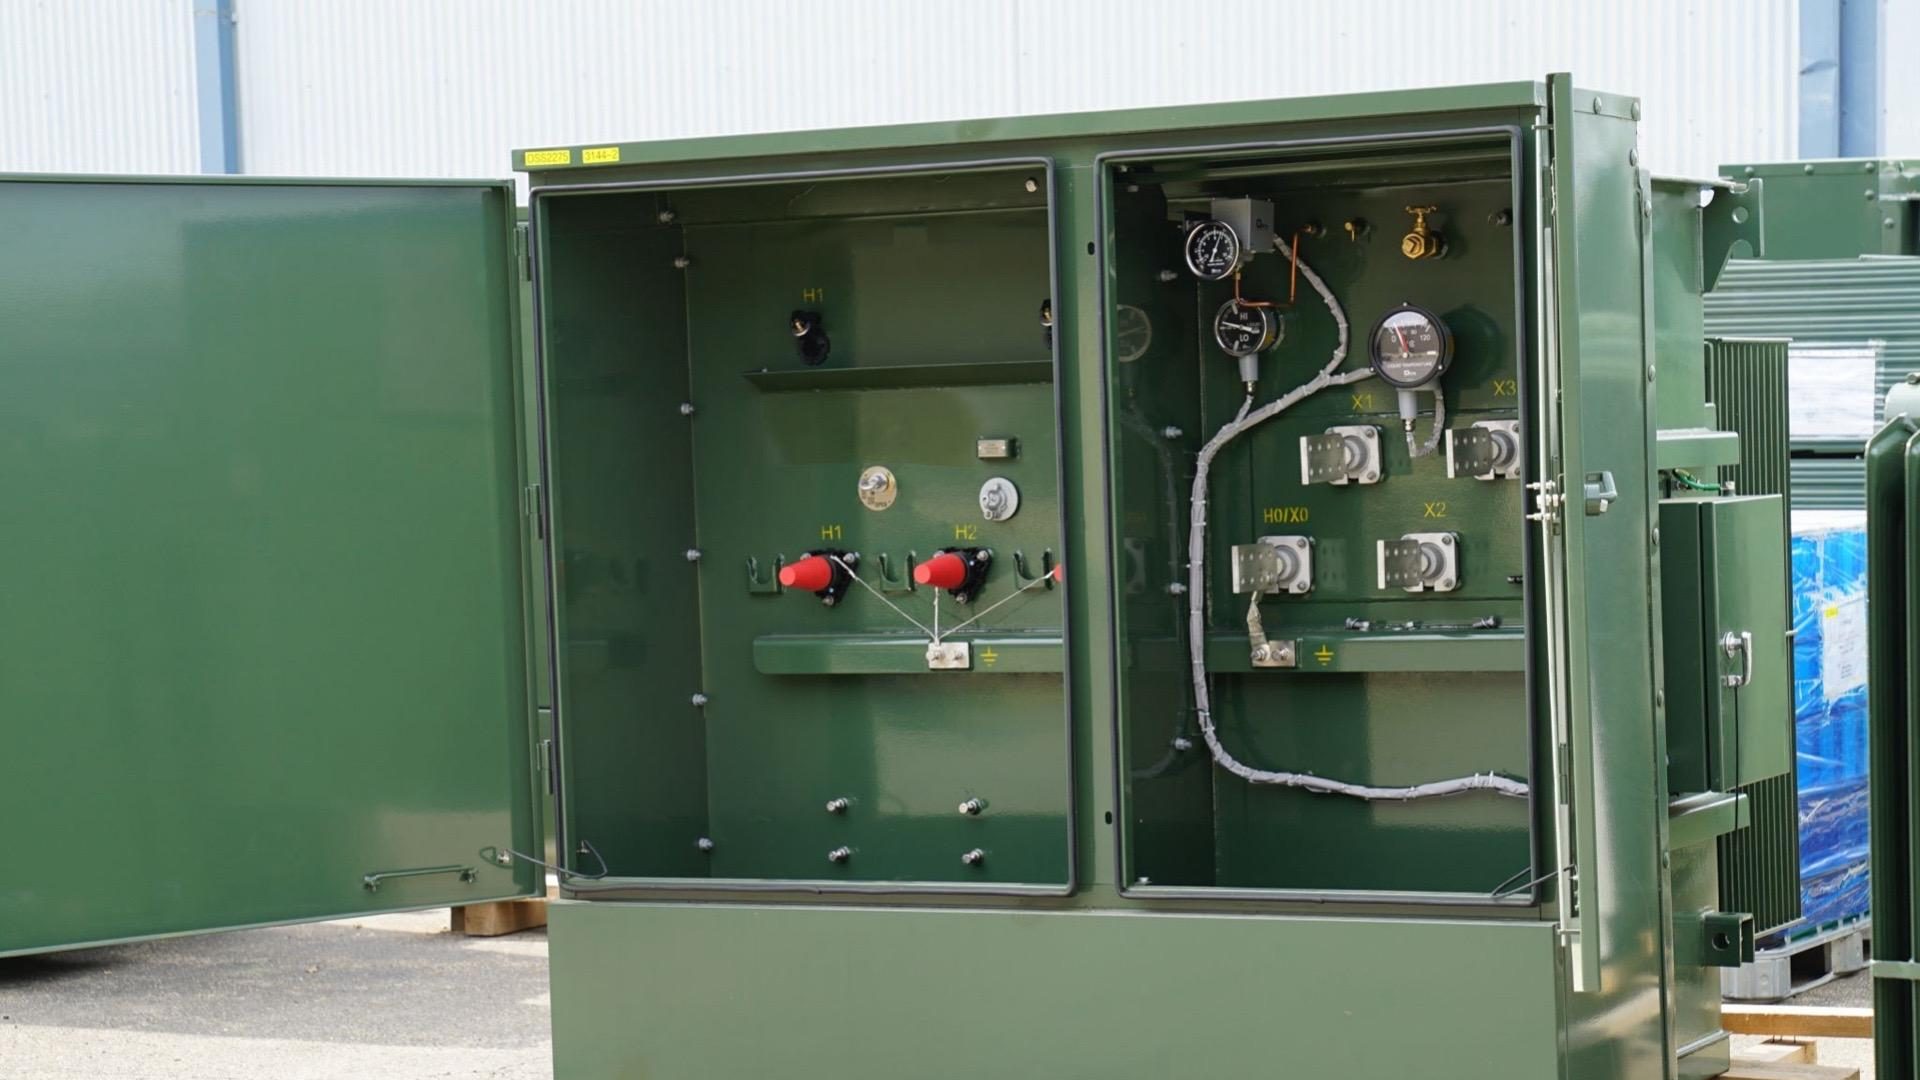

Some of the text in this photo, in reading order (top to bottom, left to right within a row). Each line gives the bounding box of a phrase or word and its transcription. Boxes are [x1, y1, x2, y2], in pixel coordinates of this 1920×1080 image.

[584, 149, 618, 161] 3144-2
[803, 287, 823, 303] H1
[1240, 312, 1249, 320] HI
[1240, 334, 1250, 342] LO
[1420, 333, 1431, 341] 120
[1493, 379, 1517, 396] X3
[1351, 393, 1374, 410] X1
[1423, 502, 1447, 518] X2
[821, 524, 842, 541] H1
[955, 524, 977, 540] H2
